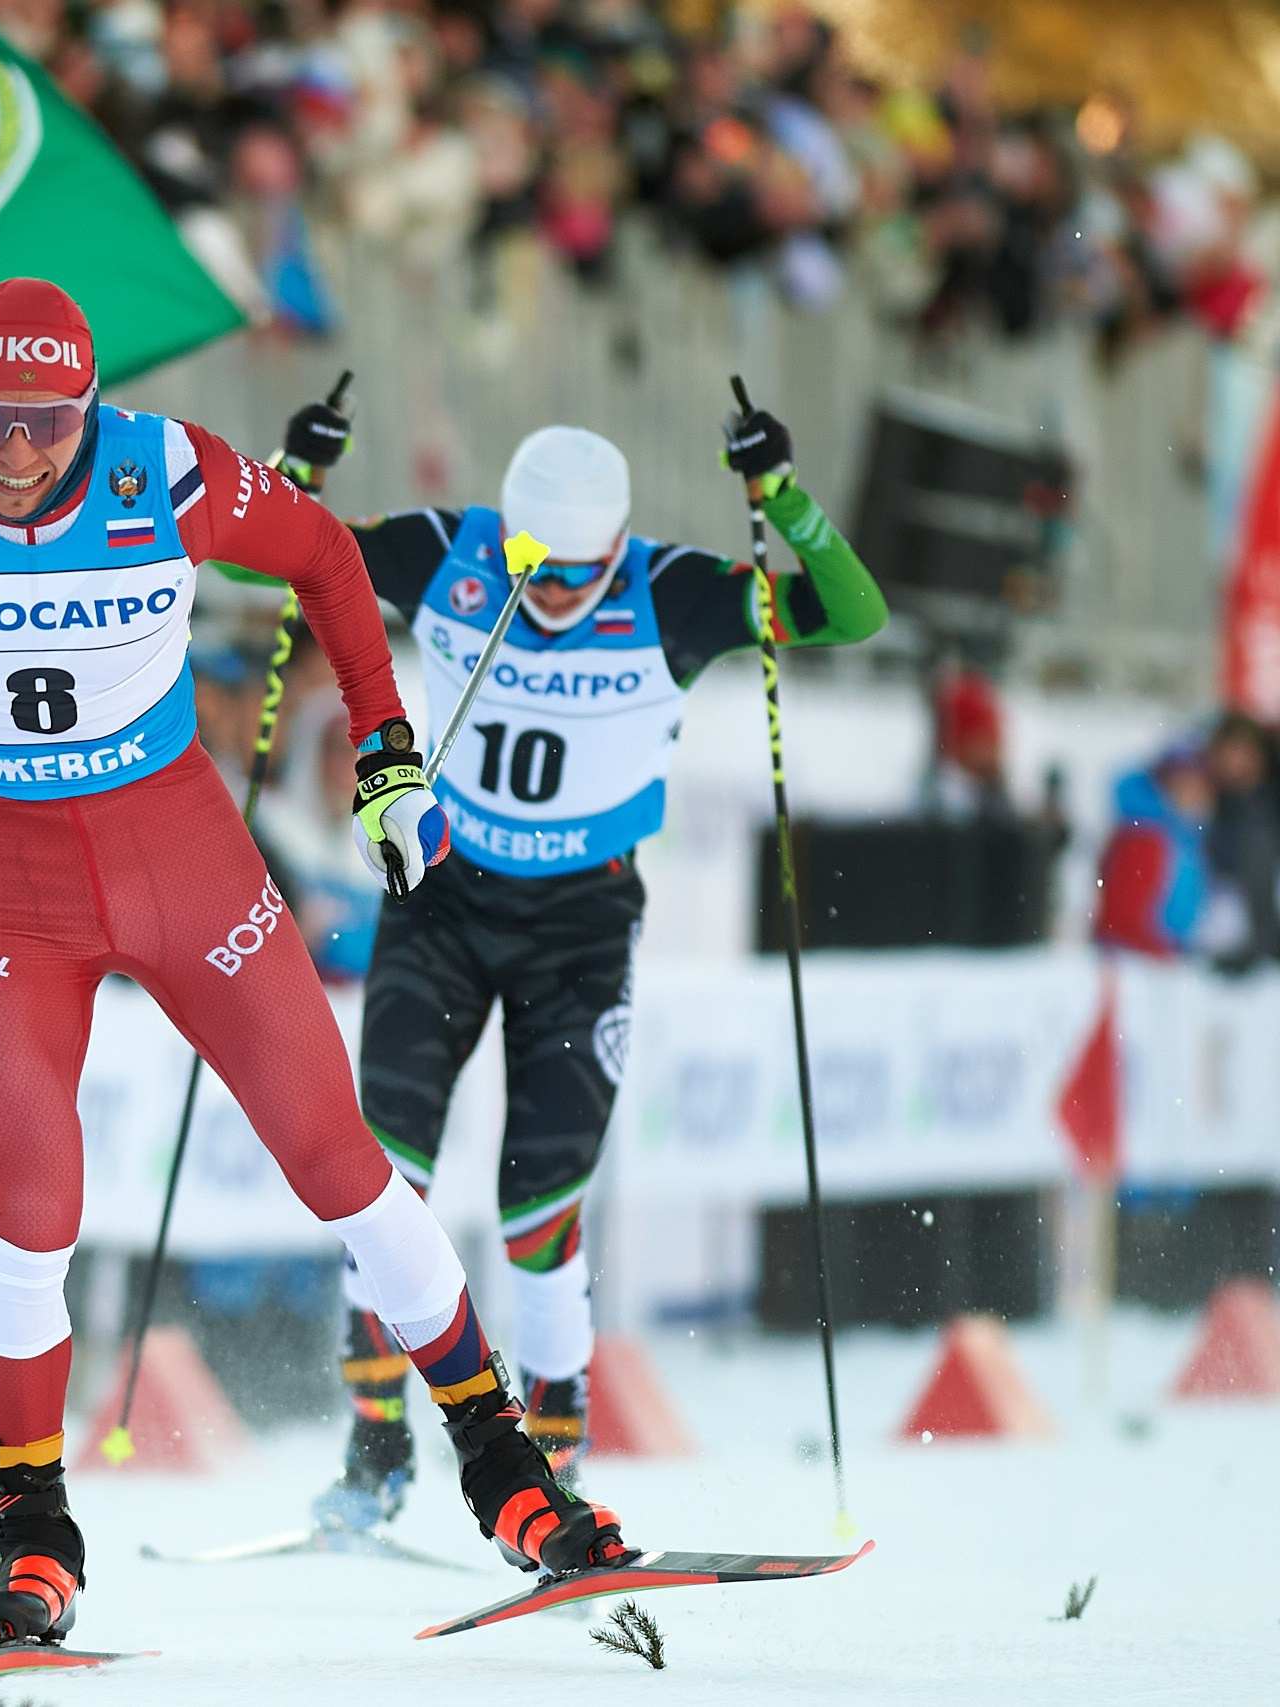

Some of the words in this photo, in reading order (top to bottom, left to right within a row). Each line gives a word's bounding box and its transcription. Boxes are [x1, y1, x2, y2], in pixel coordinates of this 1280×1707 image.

[6, 667, 78, 735] 8
[473, 720, 568, 806] 10
[441, 793, 590, 863] ИЖЕВСК
[204, 872, 283, 977] BOSCO
